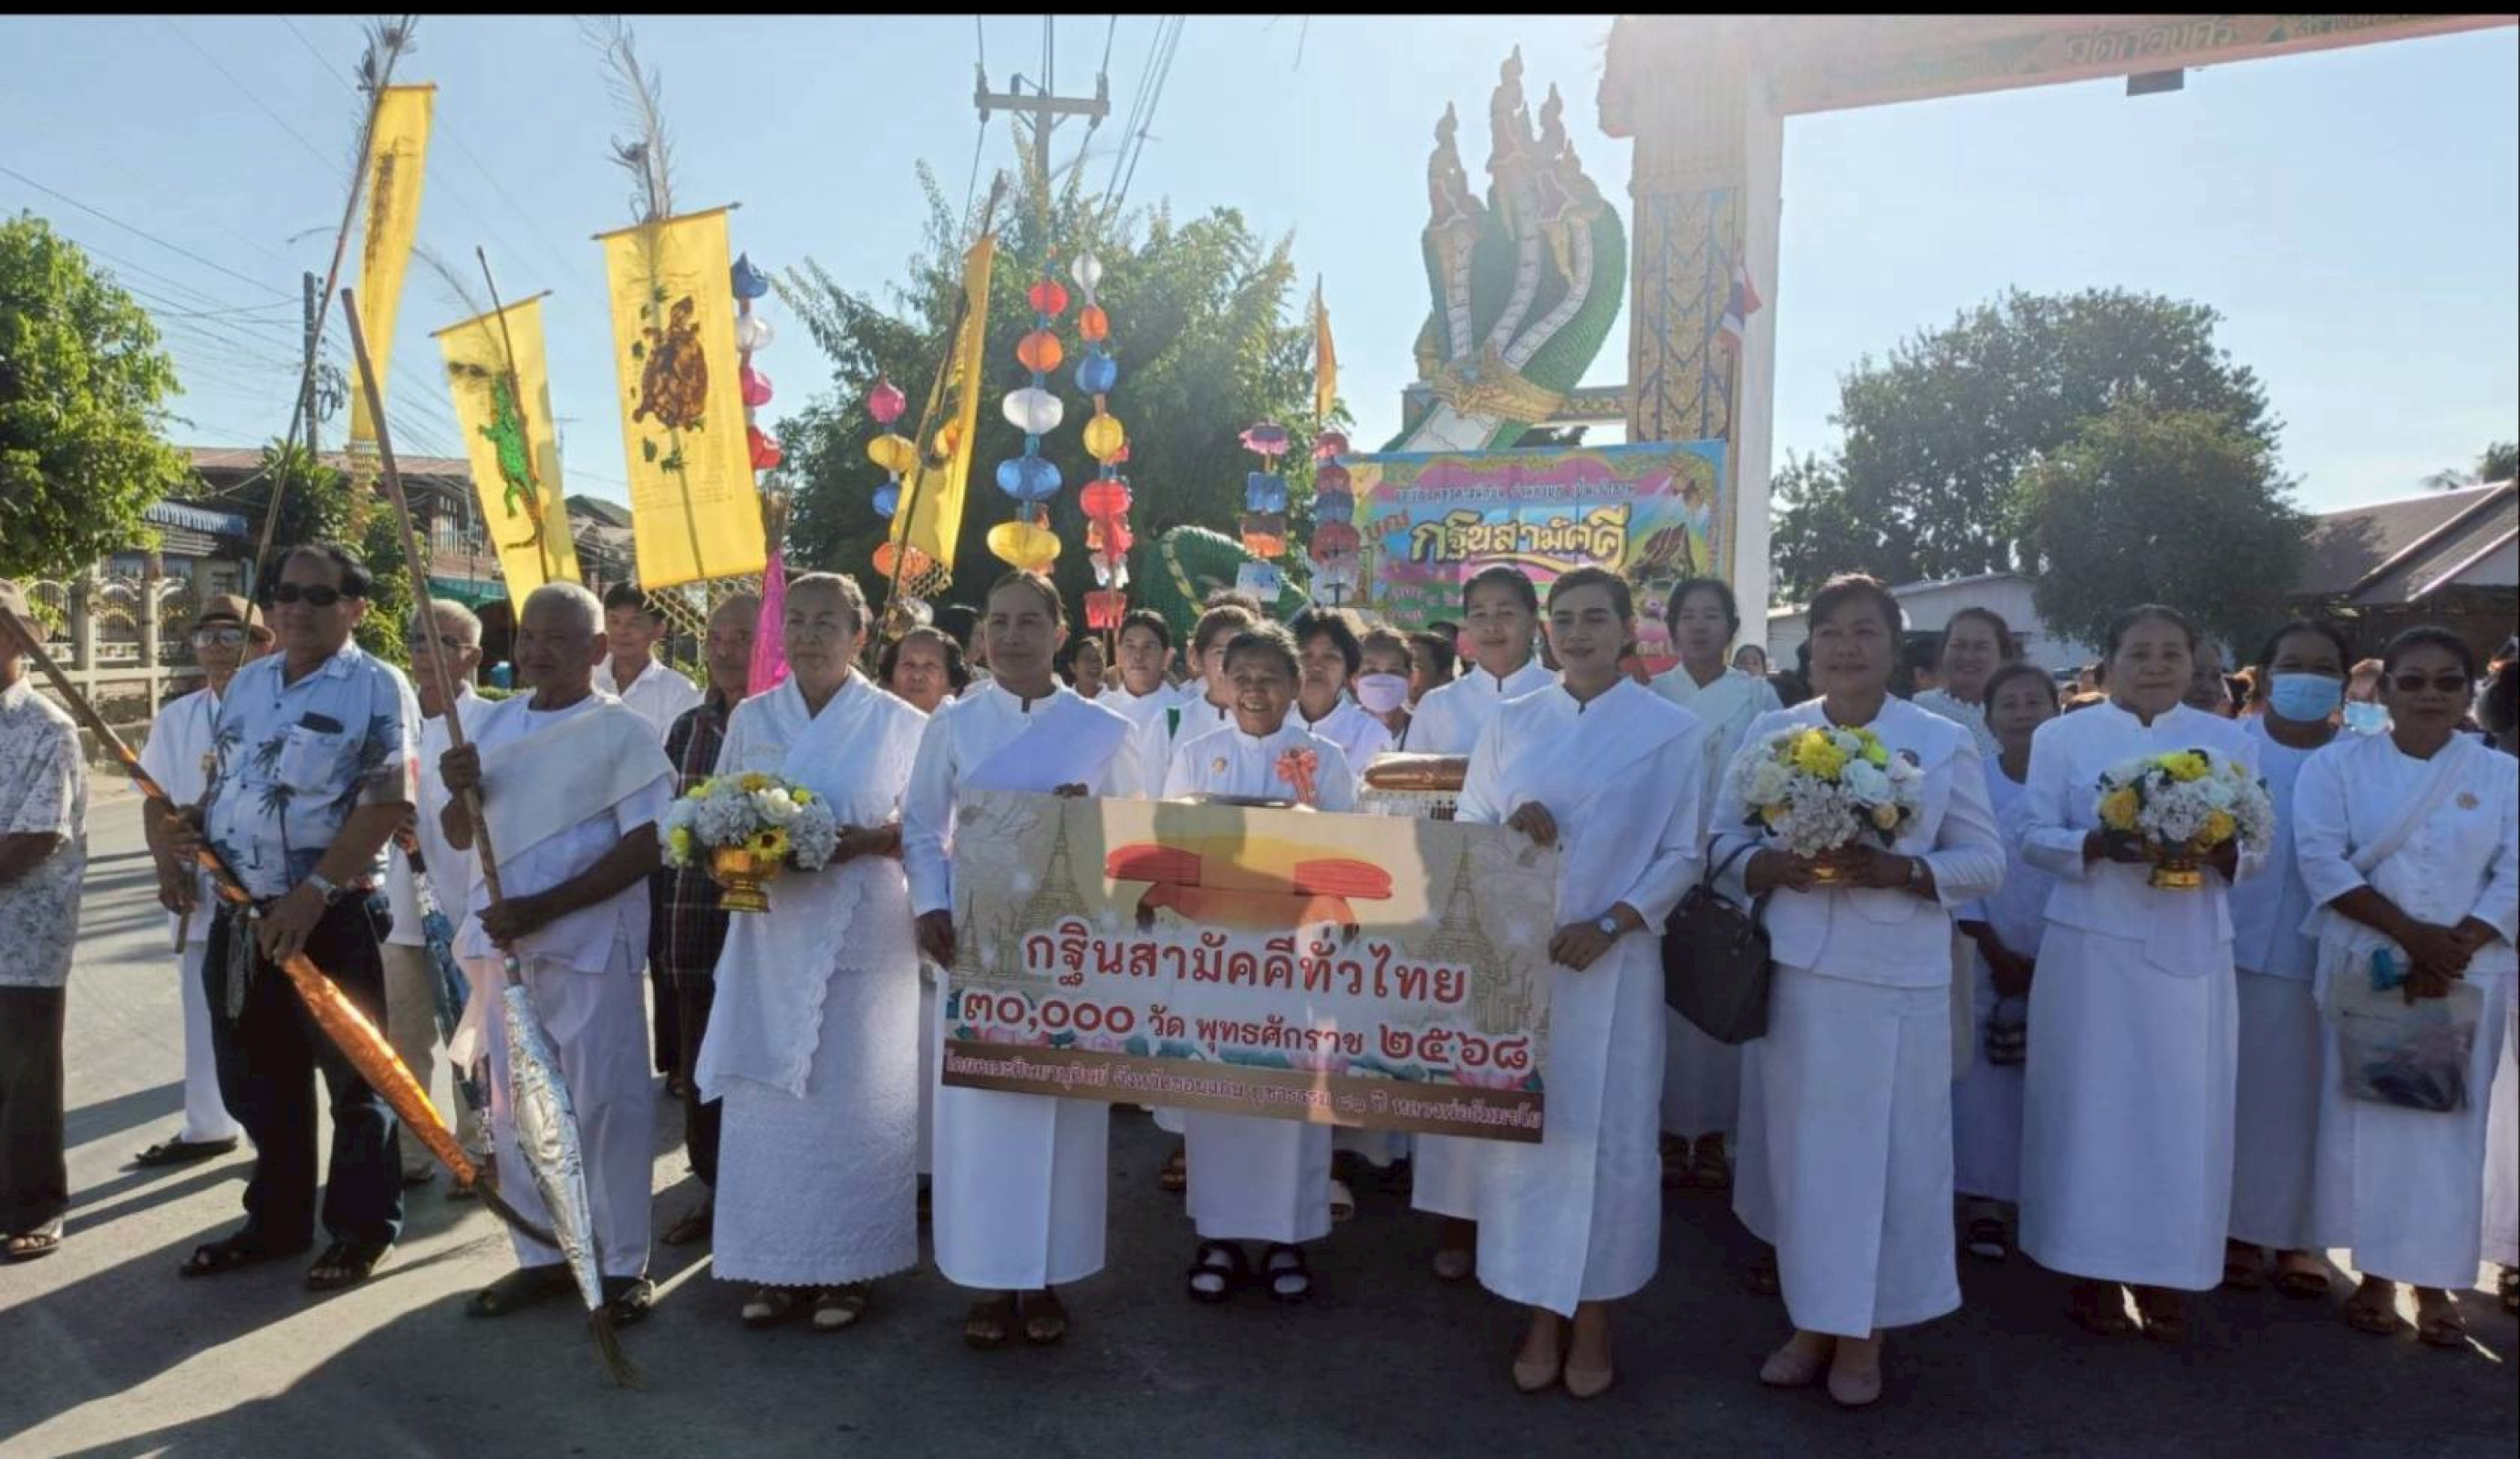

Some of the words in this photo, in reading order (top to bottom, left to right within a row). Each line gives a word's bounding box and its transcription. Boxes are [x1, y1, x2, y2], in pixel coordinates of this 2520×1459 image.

[1410, 502, 1632, 570] กฐินสามัคคี
[1026, 921, 1466, 1004] กฐินสามัคคีทั่วไทย
[964, 992, 1135, 1034] ๓๐,๐๐๐
[1147, 1003, 1186, 1038] วัด
[1379, 1024, 1530, 1071] ๒๕๖๘
